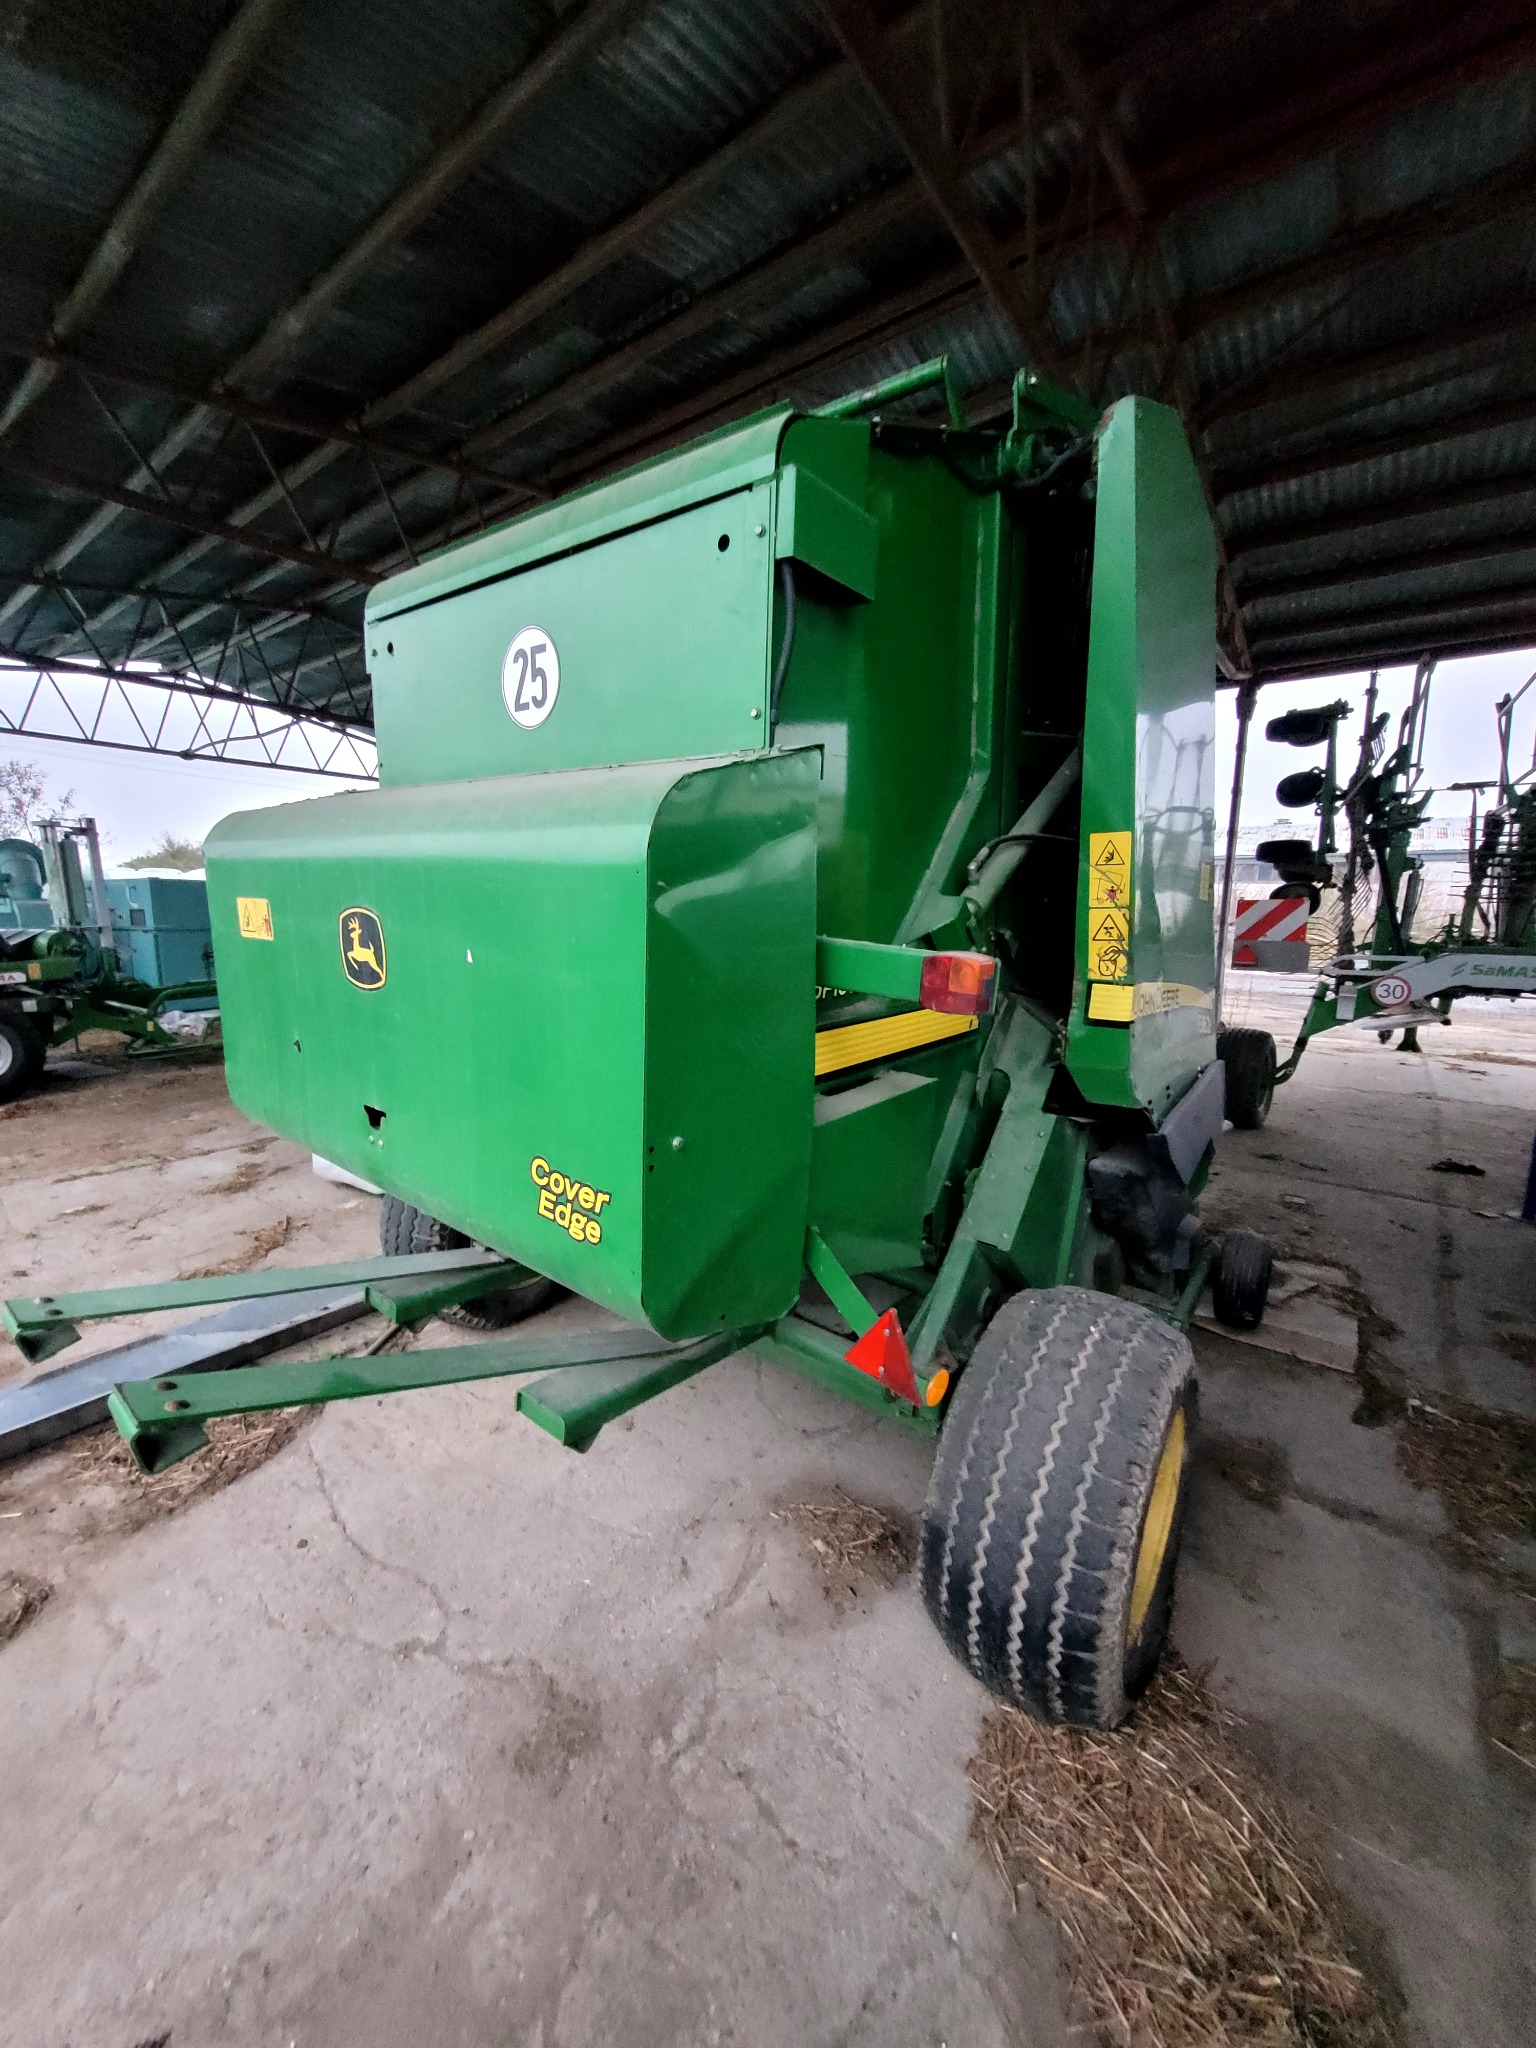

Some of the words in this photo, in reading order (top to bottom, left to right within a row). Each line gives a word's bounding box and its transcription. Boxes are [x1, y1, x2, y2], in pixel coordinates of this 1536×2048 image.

[512, 643, 548, 713] 25
[1379, 984, 1405, 999] 30
[530, 1156, 611, 1215] Cover
[538, 1188, 602, 1245] Edge
